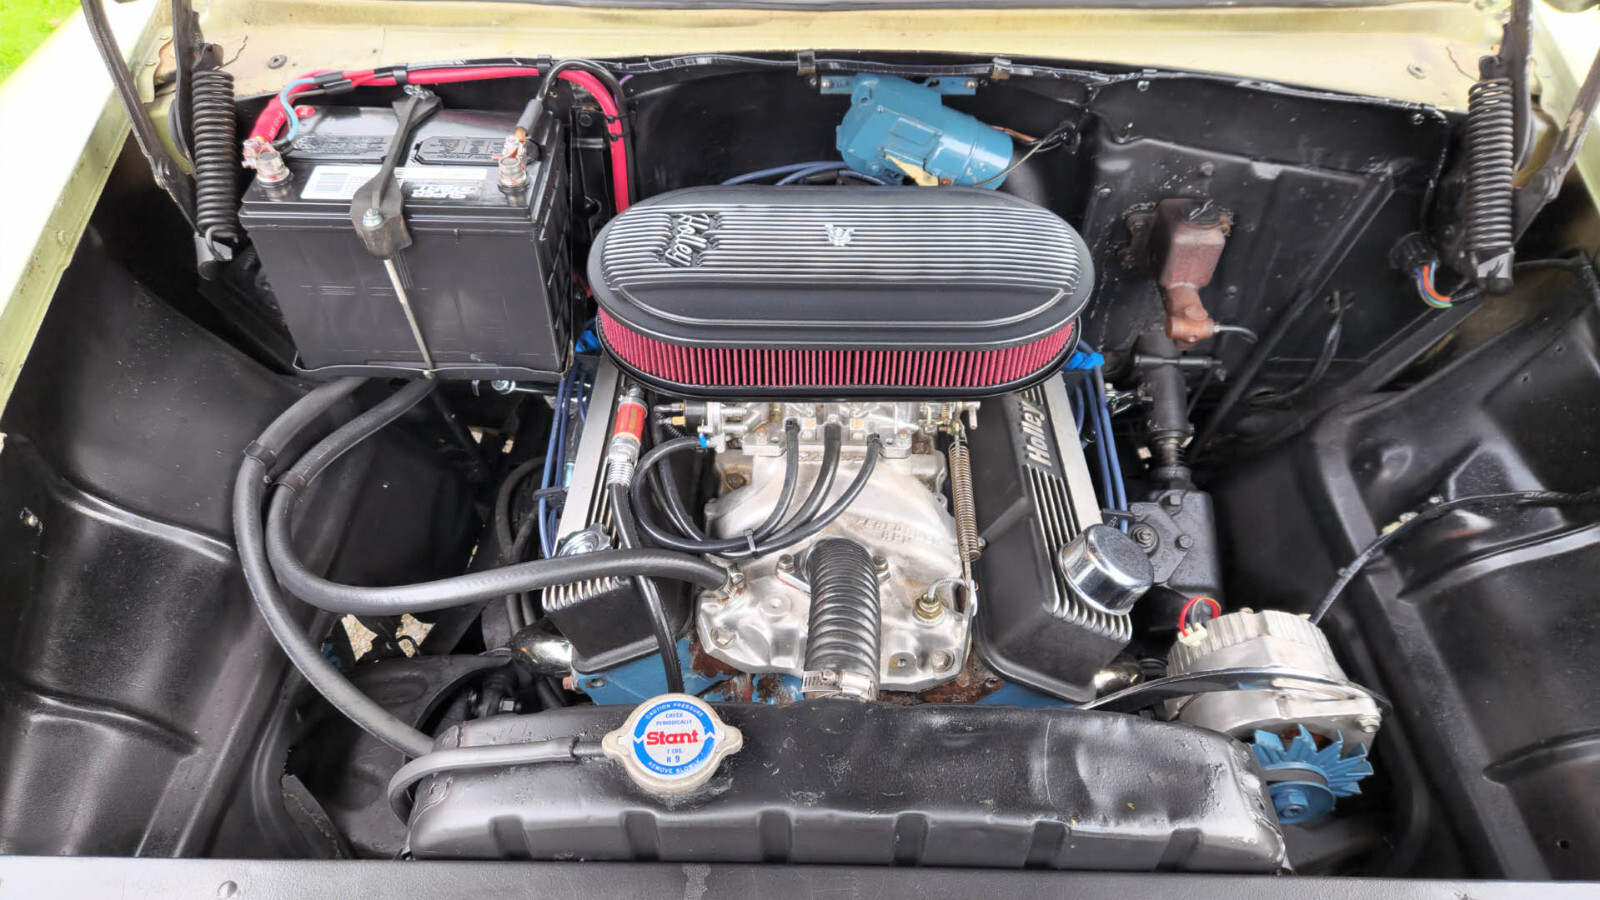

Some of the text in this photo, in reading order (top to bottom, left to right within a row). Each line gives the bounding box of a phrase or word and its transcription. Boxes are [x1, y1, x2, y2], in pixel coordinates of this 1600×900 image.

[411, 189, 467, 199] SUPER
[665, 212, 710, 267] Holley
[1021, 400, 1053, 467] Holley
[646, 702, 704, 719] CAUTION PRESSURE
[647, 730, 698, 745] Stant
[675, 755, 681, 763] 9
[647, 761, 672, 774] REMOVE
